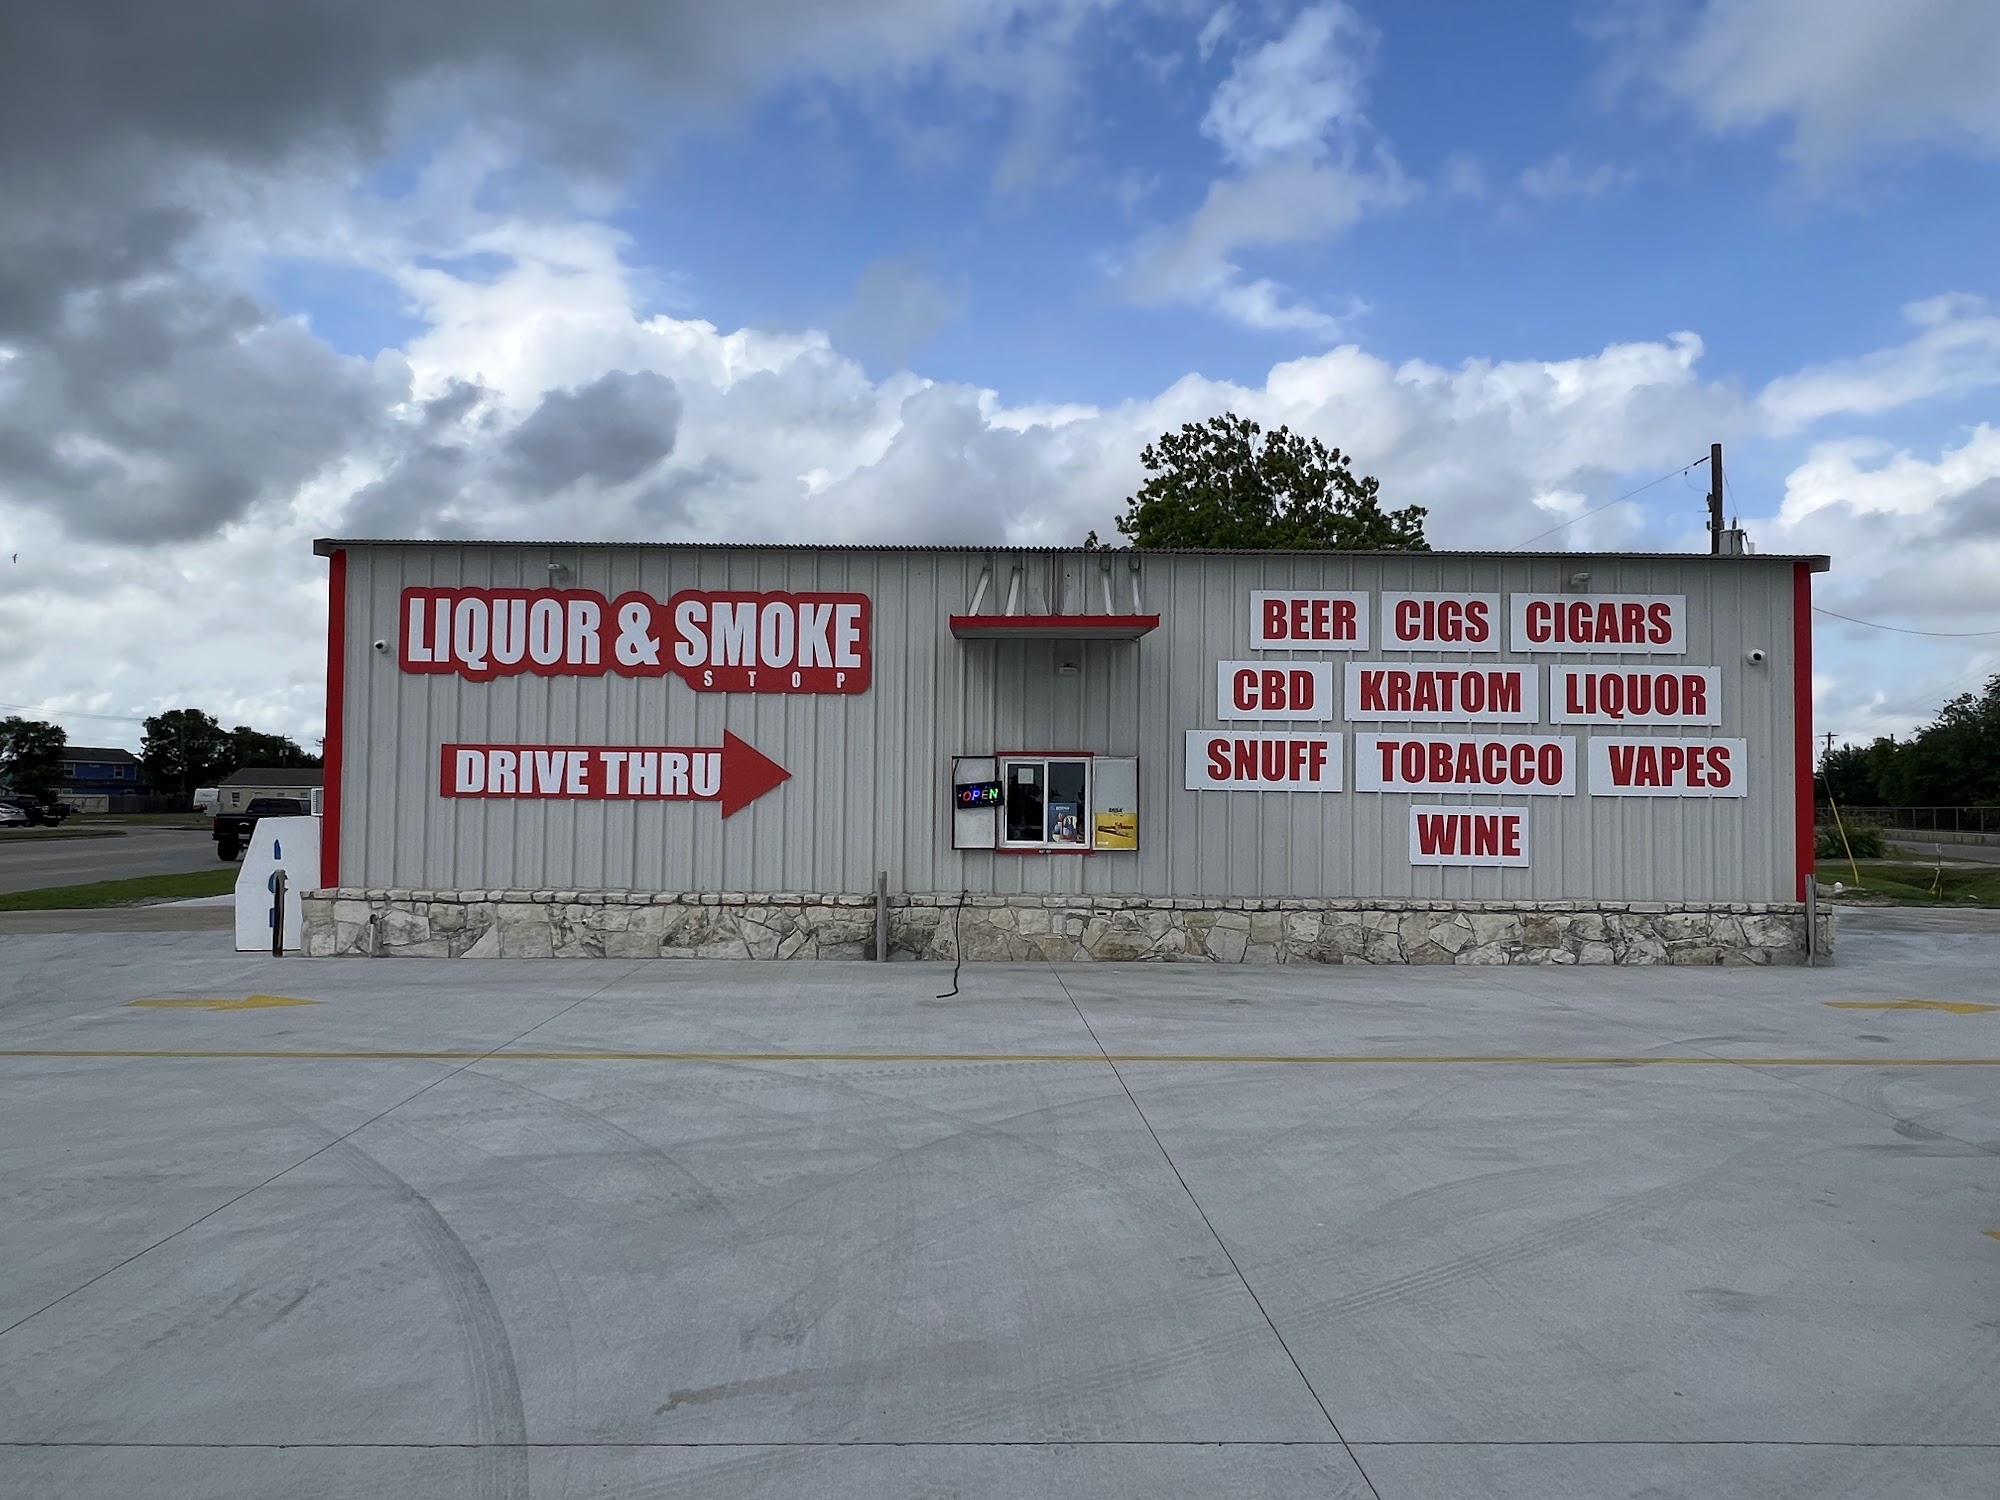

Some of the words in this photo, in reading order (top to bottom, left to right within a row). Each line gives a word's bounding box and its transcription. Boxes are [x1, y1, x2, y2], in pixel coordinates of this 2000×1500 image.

[407, 597, 602, 671] LIQUOR
[614, 601, 661, 666] &
[674, 600, 862, 669] SMOKE
[1262, 599, 1357, 641] BEER
[1395, 599, 1489, 643] CIGS
[1526, 601, 1672, 645] CIGARS
[703, 669, 846, 689] STOP
[1233, 669, 1314, 712] CBD
[1360, 670, 1522, 713] KRATOM
[1566, 673, 1707, 719] LIQUOR
[455, 749, 589, 794] DRIVE
[599, 751, 722, 797] THRU
[1207, 738, 1328, 782] SNUFF
[1376, 740, 1564, 786] TOBACCO
[1608, 745, 1732, 788] VAPES
[962, 788, 999, 801] OPEN
[1417, 814, 1521, 857] WINE
